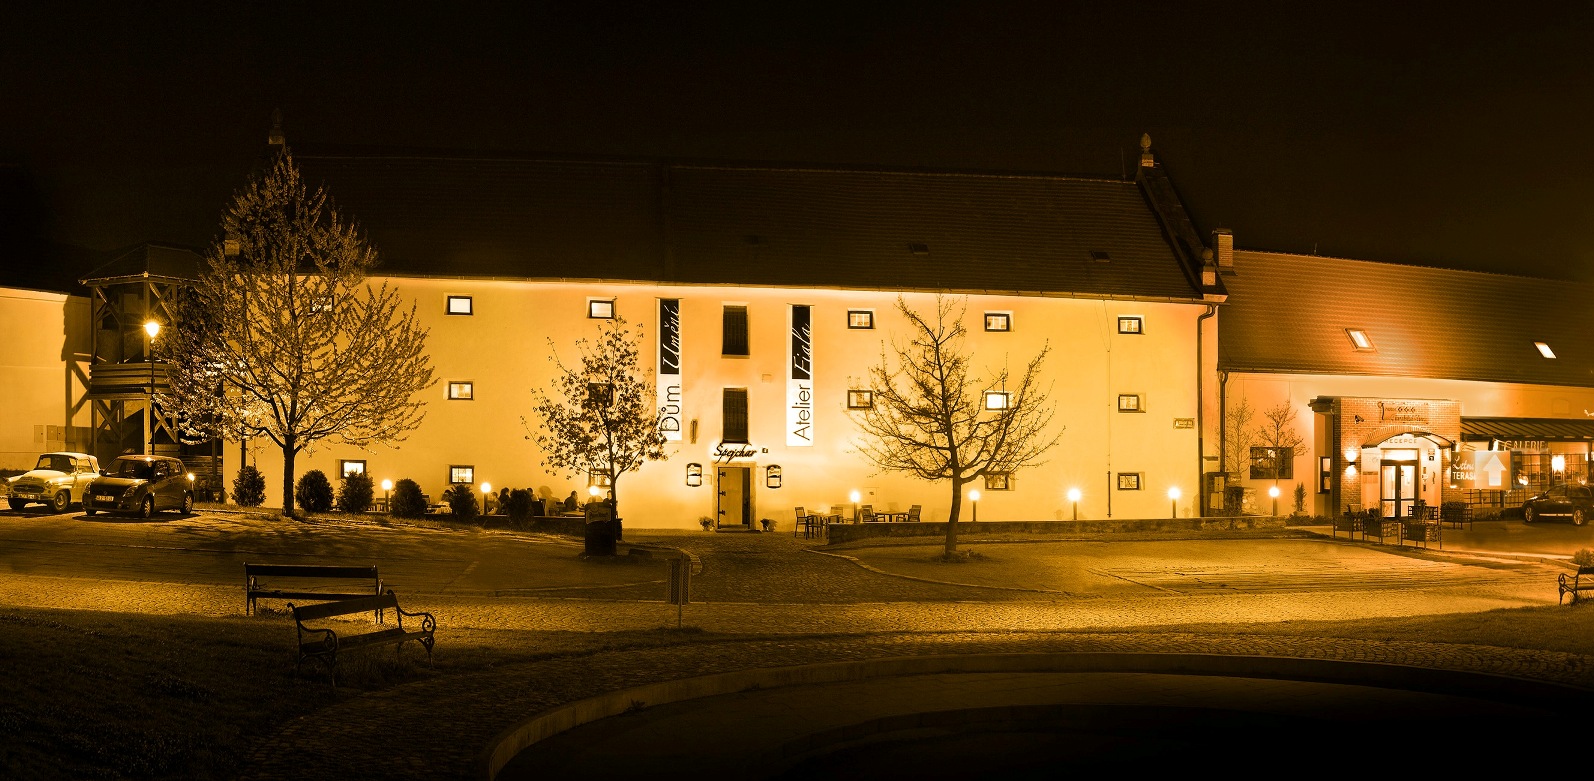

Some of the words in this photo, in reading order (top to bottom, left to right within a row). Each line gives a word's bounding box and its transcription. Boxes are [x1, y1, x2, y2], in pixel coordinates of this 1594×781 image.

[662, 304, 680, 369] Umění
[792, 322, 810, 376] Fiala
[792, 384, 810, 441] Atelier
